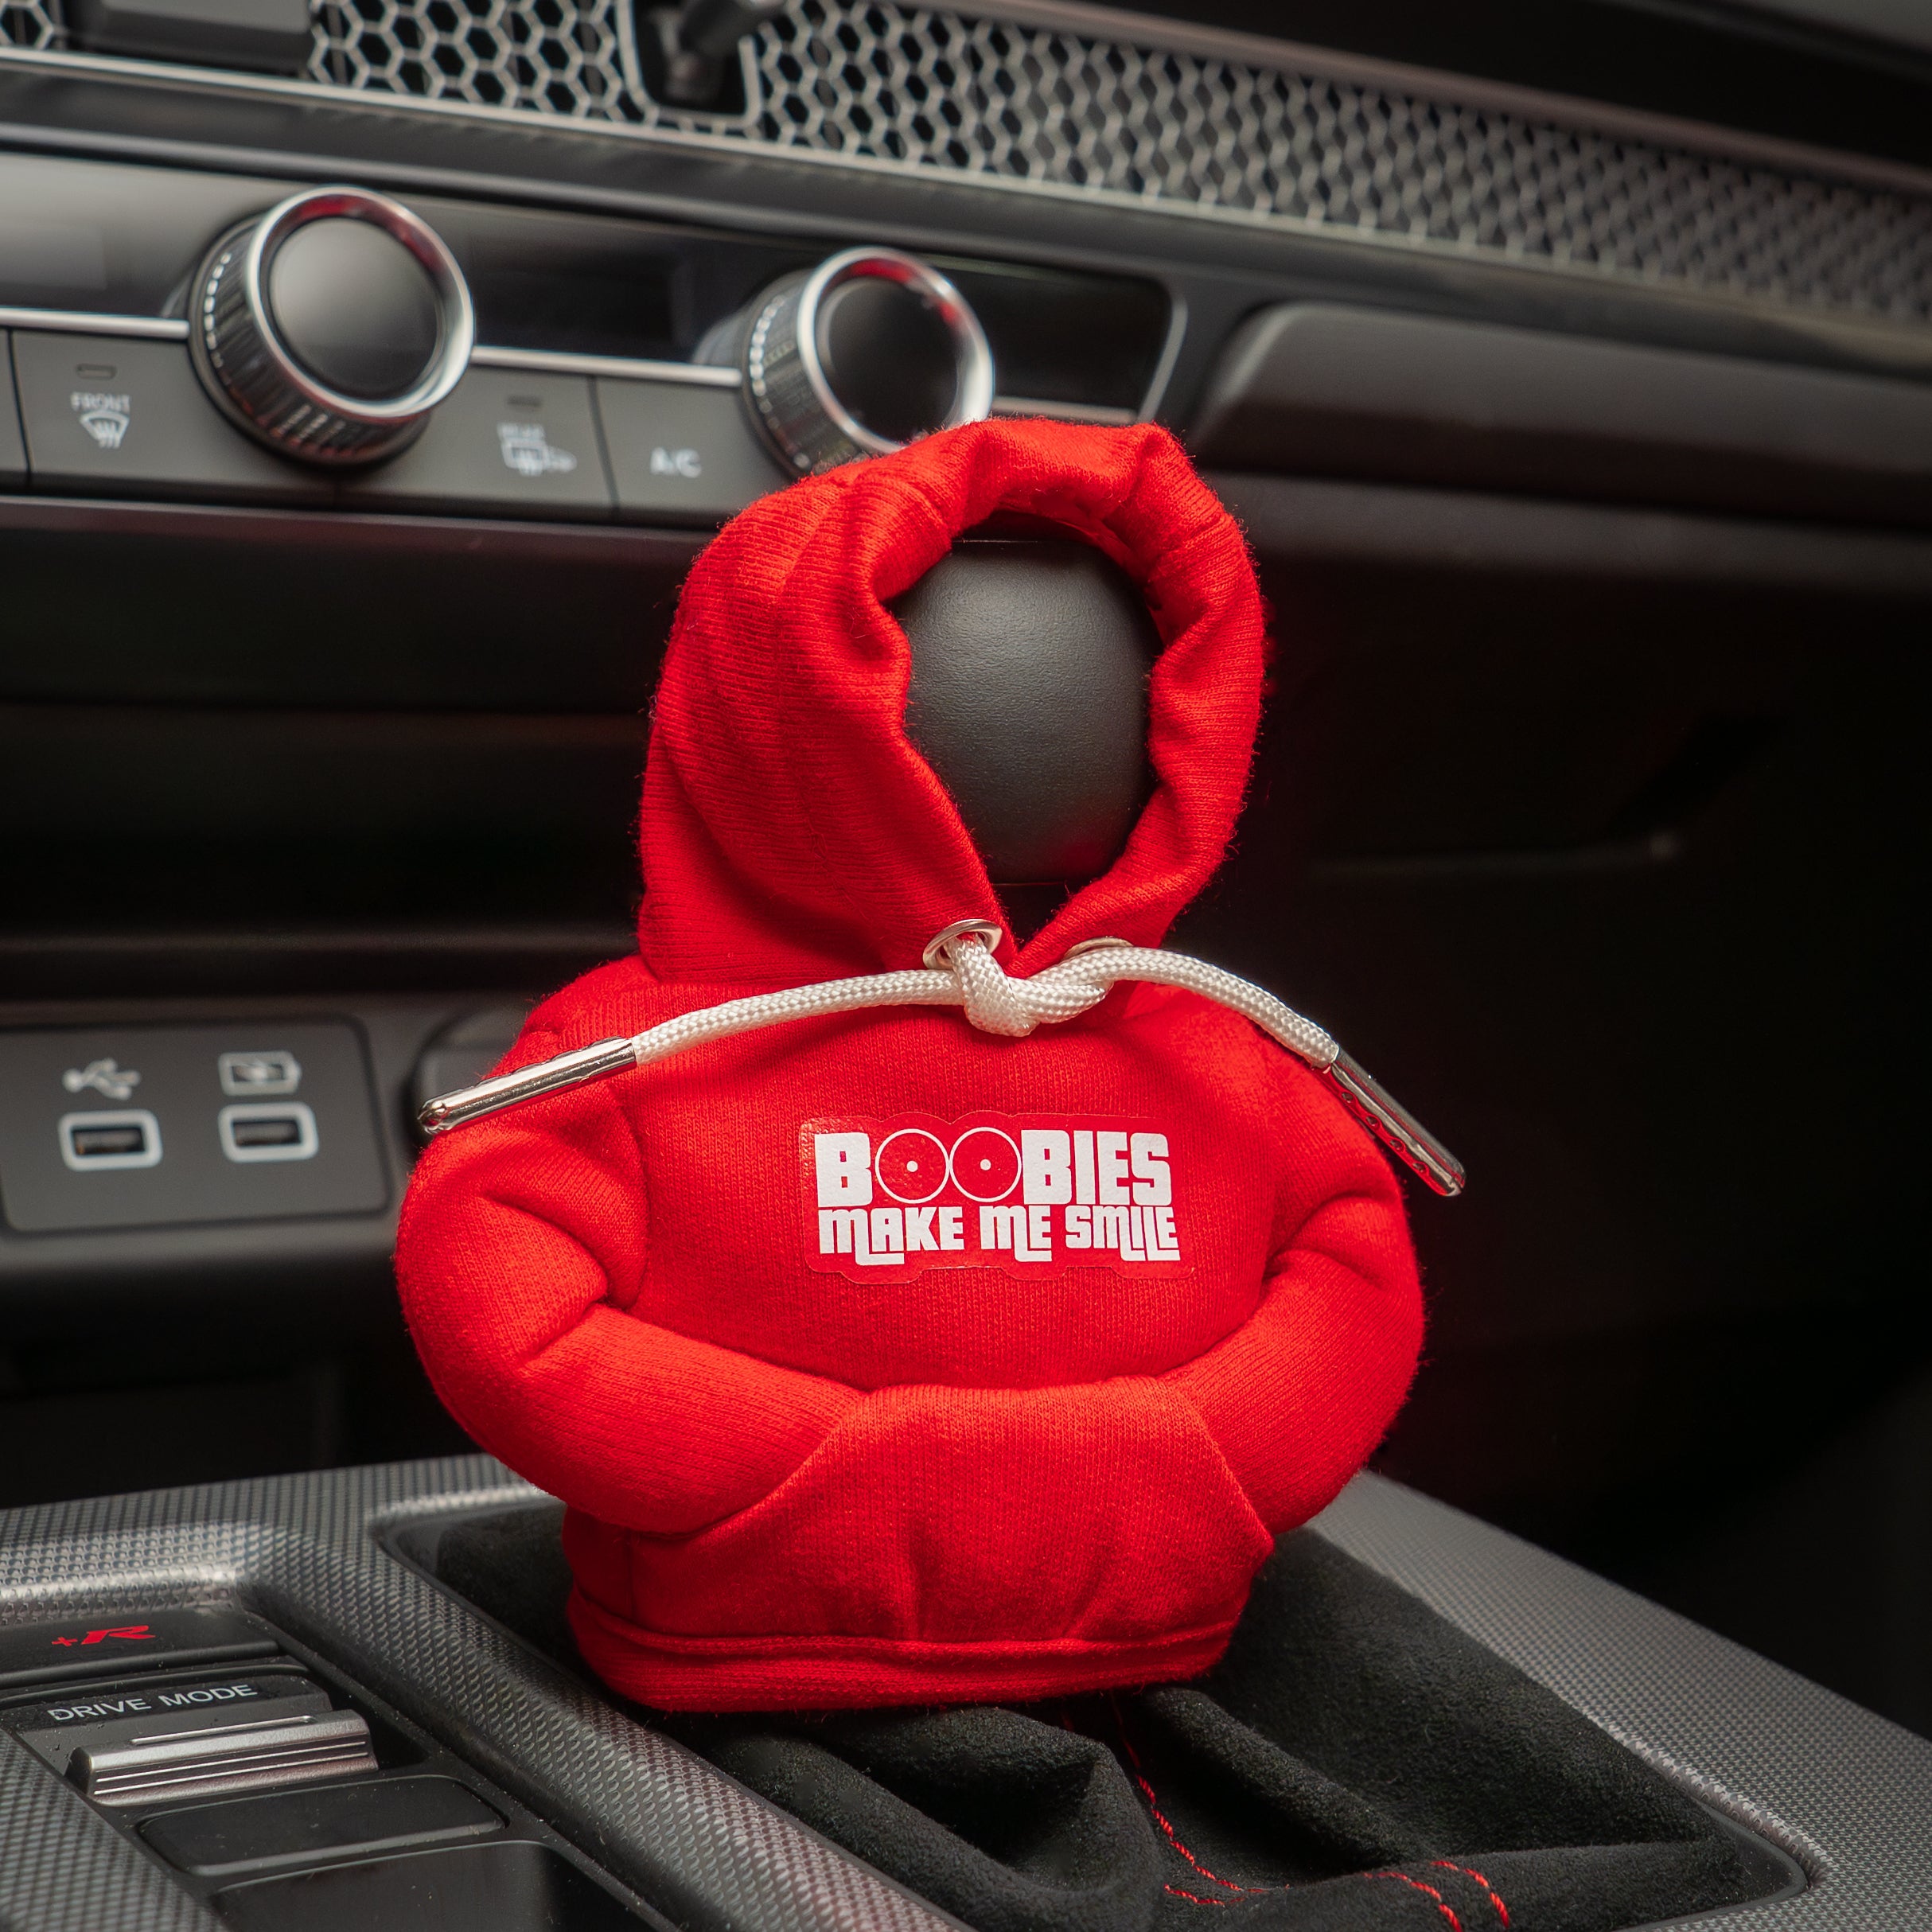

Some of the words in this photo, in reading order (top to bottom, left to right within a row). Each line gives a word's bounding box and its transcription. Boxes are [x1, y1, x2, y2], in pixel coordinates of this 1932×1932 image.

[70, 391, 130, 412] FRONT
[814, 1127, 1173, 1206] BOOBIES
[818, 1206, 965, 1265] MAKE
[980, 1206, 1053, 1262] ME
[1065, 1205, 1181, 1262] SMILE
[48, 1698, 152, 1721] DRIVE
[159, 1684, 258, 1707] MODE
